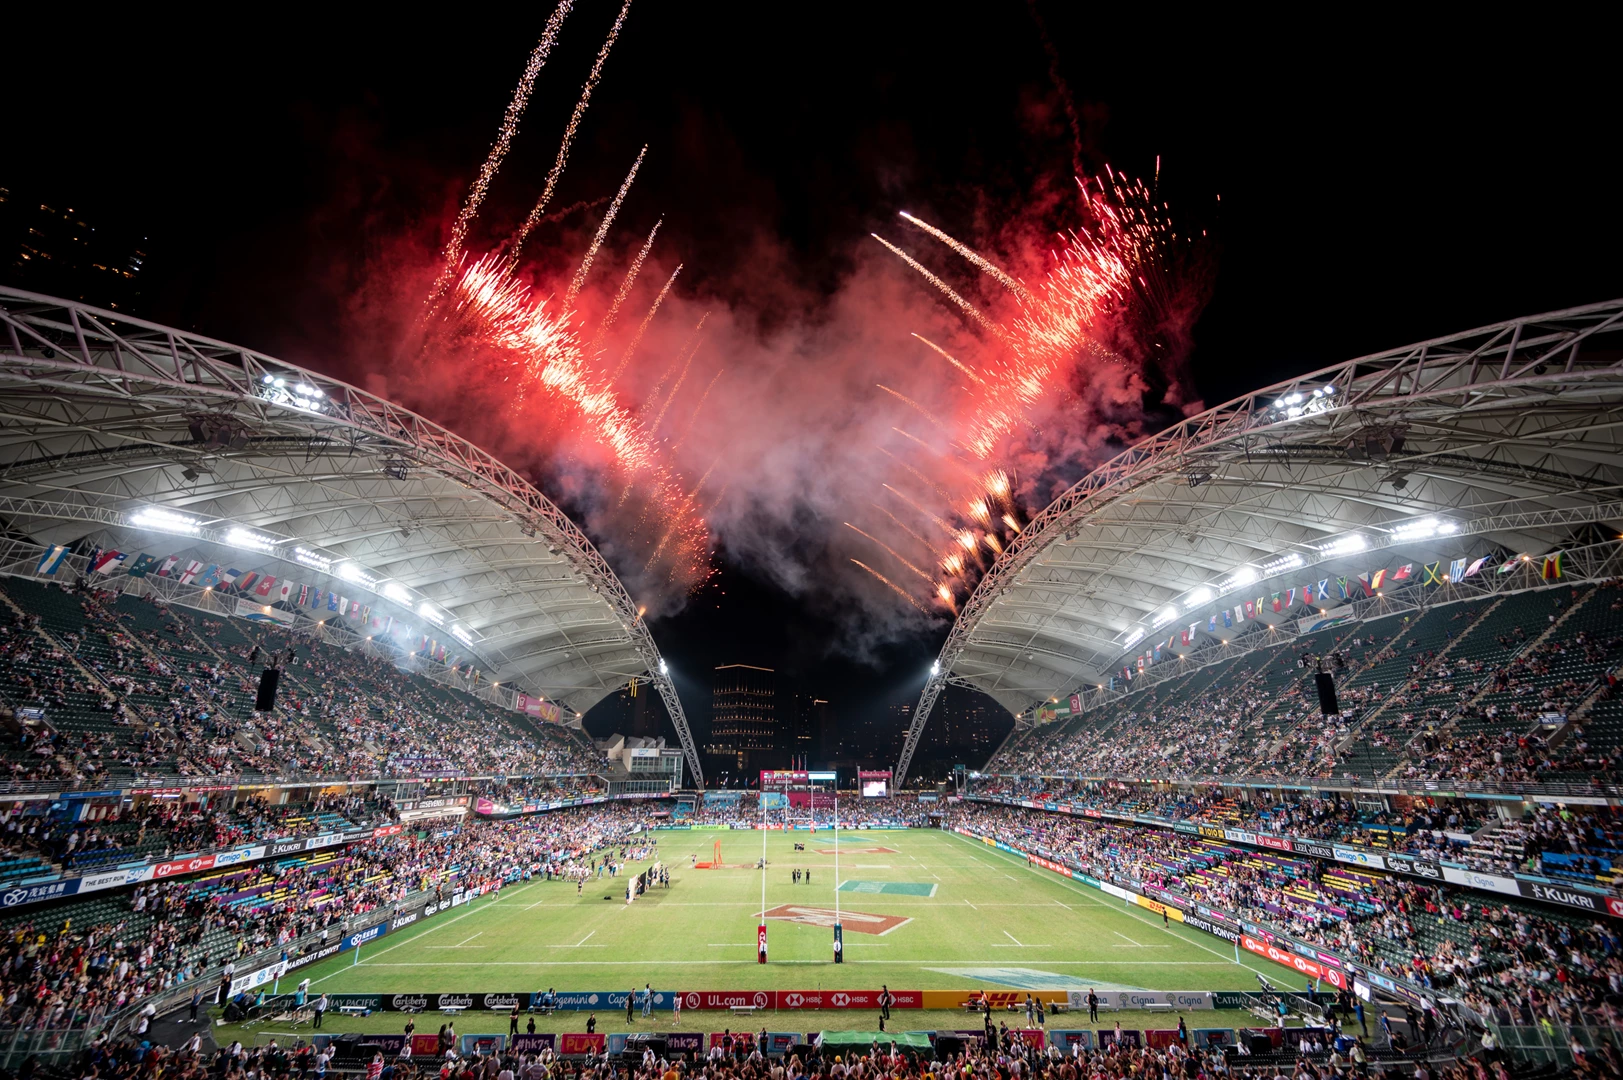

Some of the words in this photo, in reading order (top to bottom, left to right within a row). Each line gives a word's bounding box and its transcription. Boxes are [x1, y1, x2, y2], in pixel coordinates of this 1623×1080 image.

[278, 843, 301, 853] KUKRI
[217, 853, 241, 863] Cimigo
[1335, 850, 1357, 862] Cimigo
[127, 869, 145, 881] SAP
[1413, 862, 1439, 877] Carlsberg
[97, 878, 112, 886] BEST
[1473, 876, 1495, 887] Cigna
[1544, 887, 1595, 909] KUKRI
[397, 913, 417, 927] KUKRI
[1183, 914, 1212, 933] MARRIOTT
[285, 952, 318, 970] MARRIOTT
[346, 999, 379, 1007] PACIFIC
[392, 994, 428, 1008] Carlsberg
[438, 994, 473, 1008] Carlsberg
[484, 993, 519, 1007] Carlsberg
[707, 995, 746, 1006] UL.com
[1084, 995, 1108, 1004] Cna
[1131, 996, 1155, 1006] Cigna
[1178, 995, 1202, 1006] Cigna
[1216, 996, 1248, 1005] CATHAY
